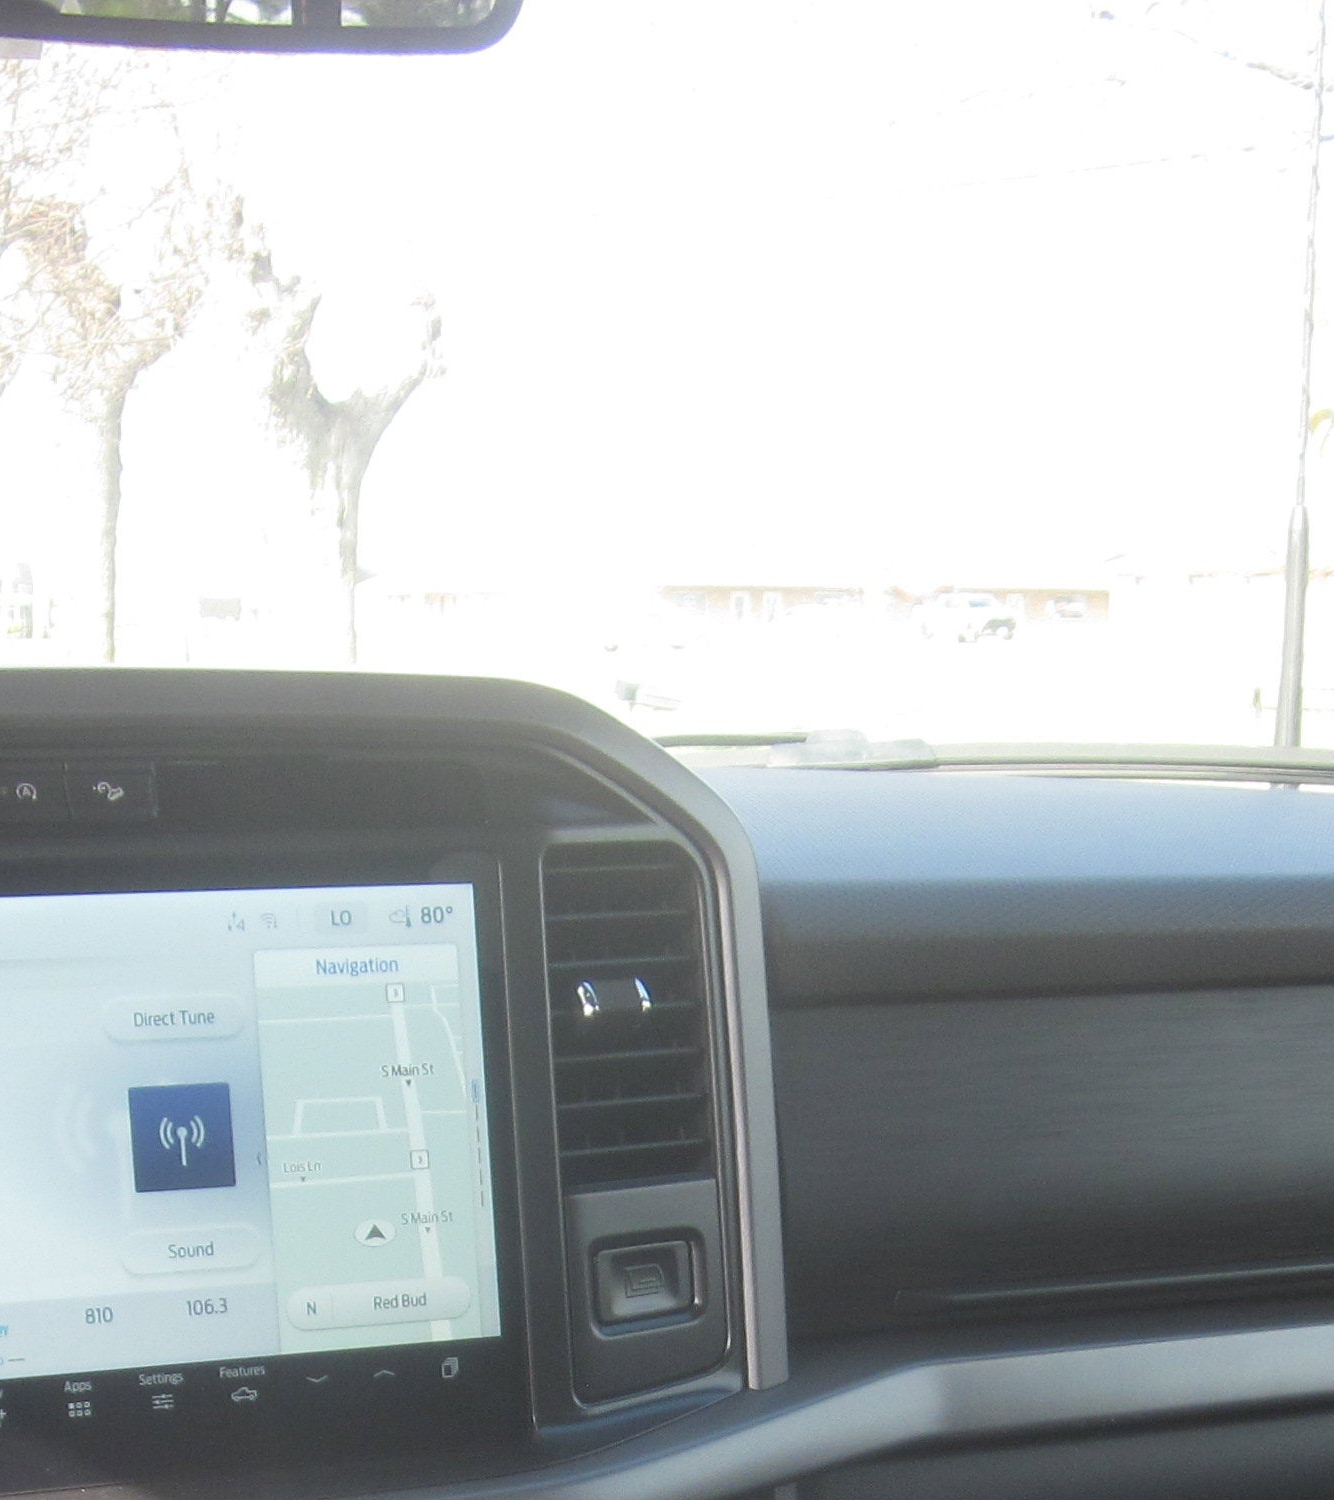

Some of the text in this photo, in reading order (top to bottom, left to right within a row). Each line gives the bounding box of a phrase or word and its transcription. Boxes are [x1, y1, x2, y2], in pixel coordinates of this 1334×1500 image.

[330, 910, 352, 927] LO
[315, 957, 399, 977] Navigation
[133, 1009, 215, 1028] Direct Tune
[381, 1063, 434, 1077] S Main St
[401, 1210, 454, 1224] S Main St
[168, 1242, 214, 1260] Sound
[186, 1298, 228, 1317] 106.3
[307, 1301, 317, 1315] N
[373, 1292, 427, 1311] Red Bud
[85, 1306, 114, 1325] 810
[139, 1371, 184, 1387] Settings
[219, 1364, 265, 1378] Features
[64, 1380, 92, 1394] Apps
